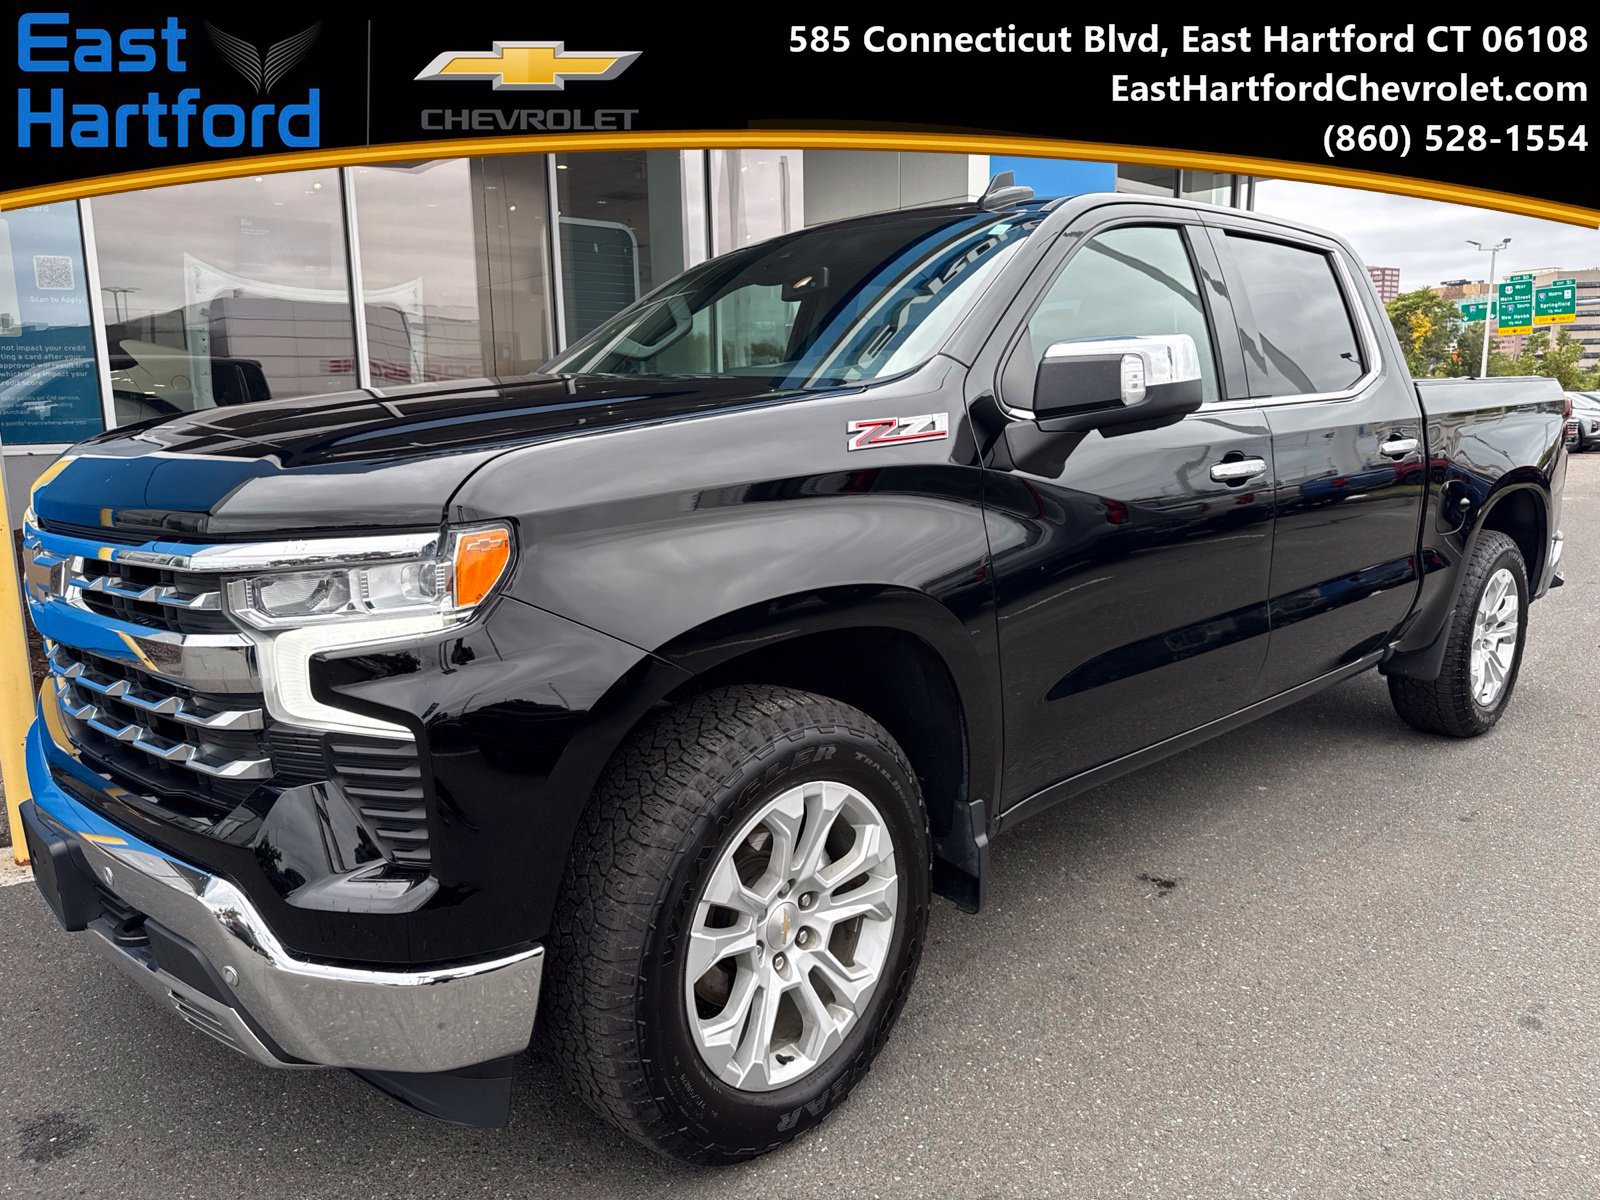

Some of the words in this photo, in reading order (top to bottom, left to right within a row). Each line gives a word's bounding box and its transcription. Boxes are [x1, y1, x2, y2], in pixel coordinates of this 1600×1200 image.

[61, 296, 85, 304] Apply!
[1540, 301, 1571, 309] Springfield
[16, 345, 43, 353] impact
[44, 345, 62, 353] your
[0, 362, 35, 370] approved
[42, 371, 69, 379] impact
[847, 412, 948, 452] Z71
